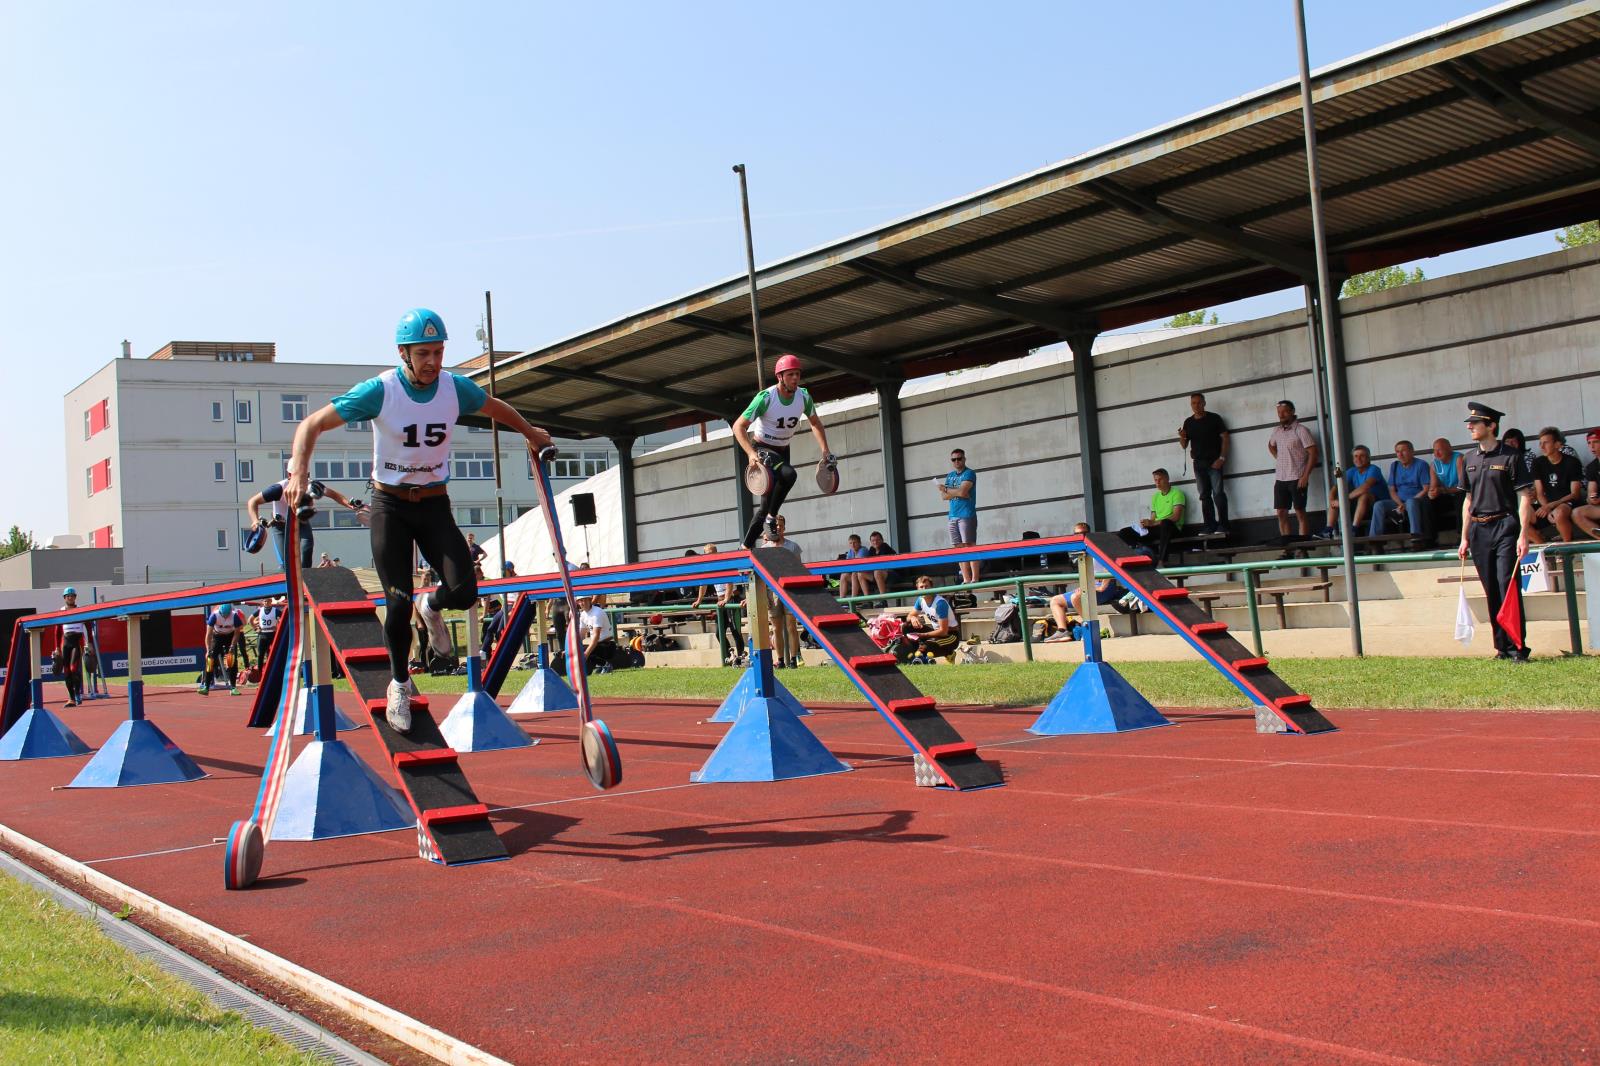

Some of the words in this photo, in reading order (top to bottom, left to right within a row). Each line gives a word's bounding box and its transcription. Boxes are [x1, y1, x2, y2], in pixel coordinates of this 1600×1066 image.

[775, 416, 799, 429] 13
[402, 422, 447, 448] 15
[384, 462, 397, 471] HZS
[1520, 563, 1540, 574] HAY
[262, 618, 272, 626] 20
[140, 657, 179, 667] UDĚJOVICE
